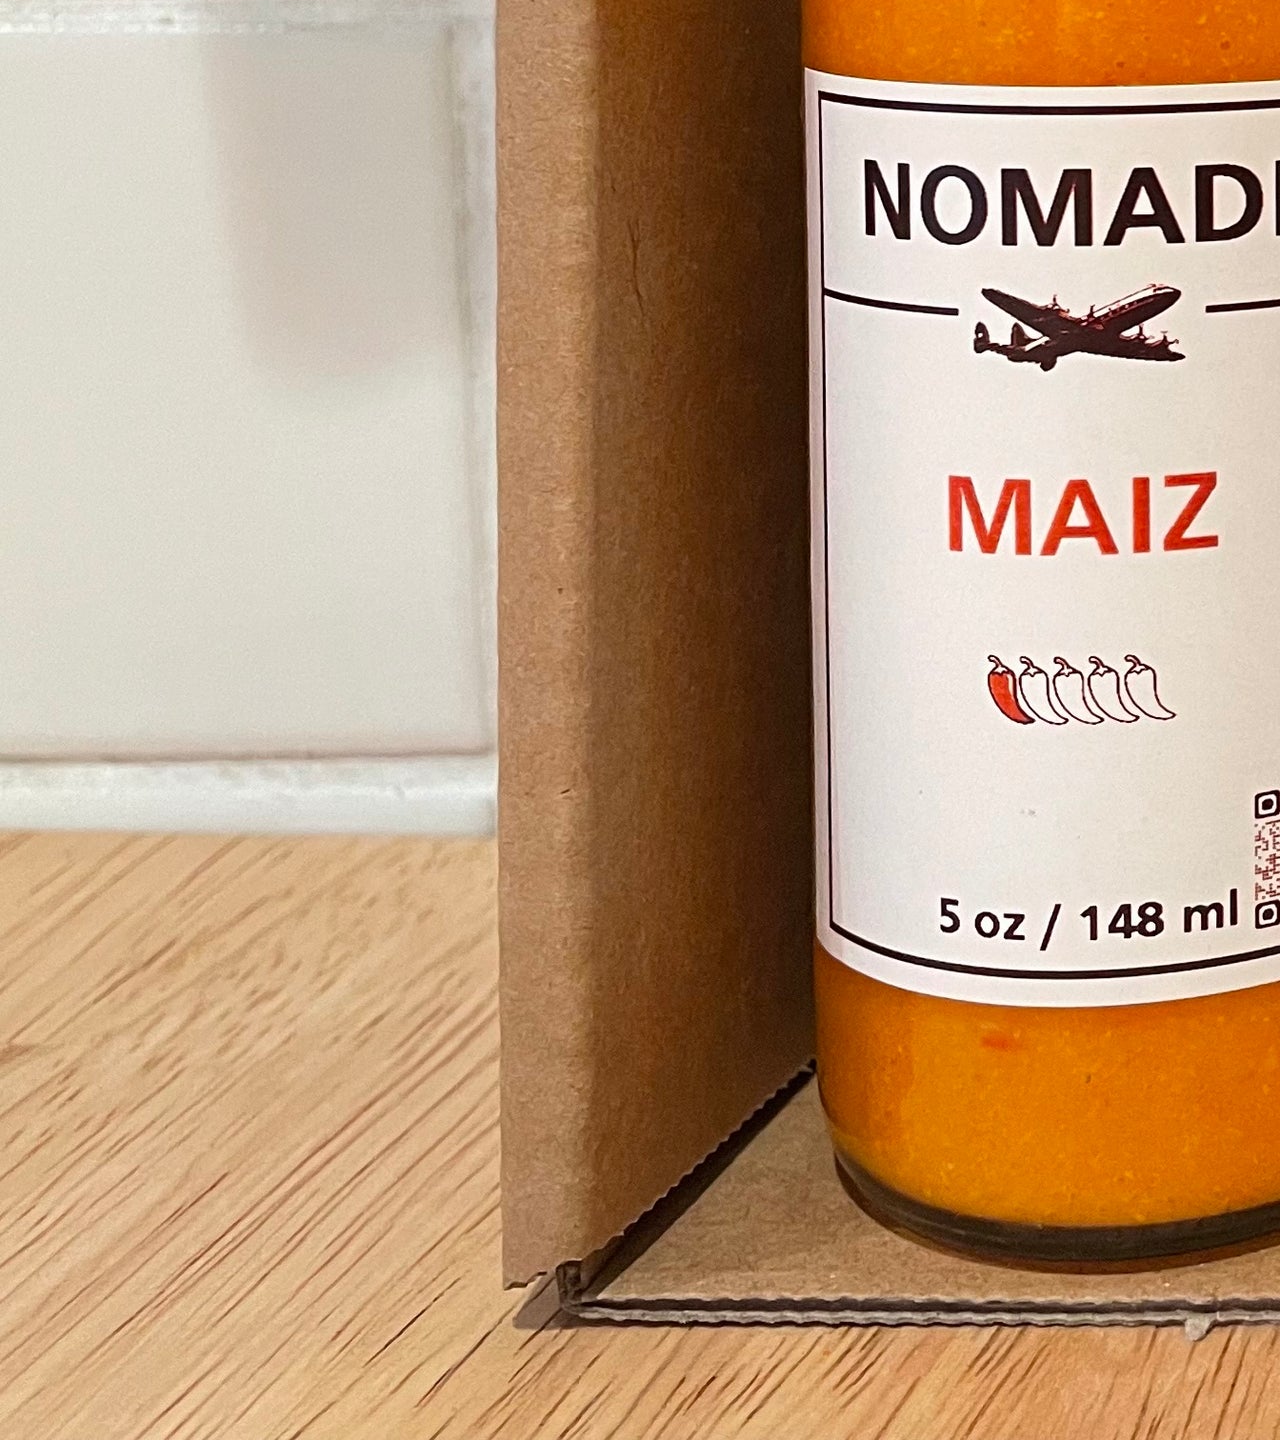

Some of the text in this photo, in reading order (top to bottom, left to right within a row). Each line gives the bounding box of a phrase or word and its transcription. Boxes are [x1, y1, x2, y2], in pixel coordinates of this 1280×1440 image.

[948, 471, 1219, 556] MAIZ
[939, 888, 1238, 952] 5 oz / 148 ml
